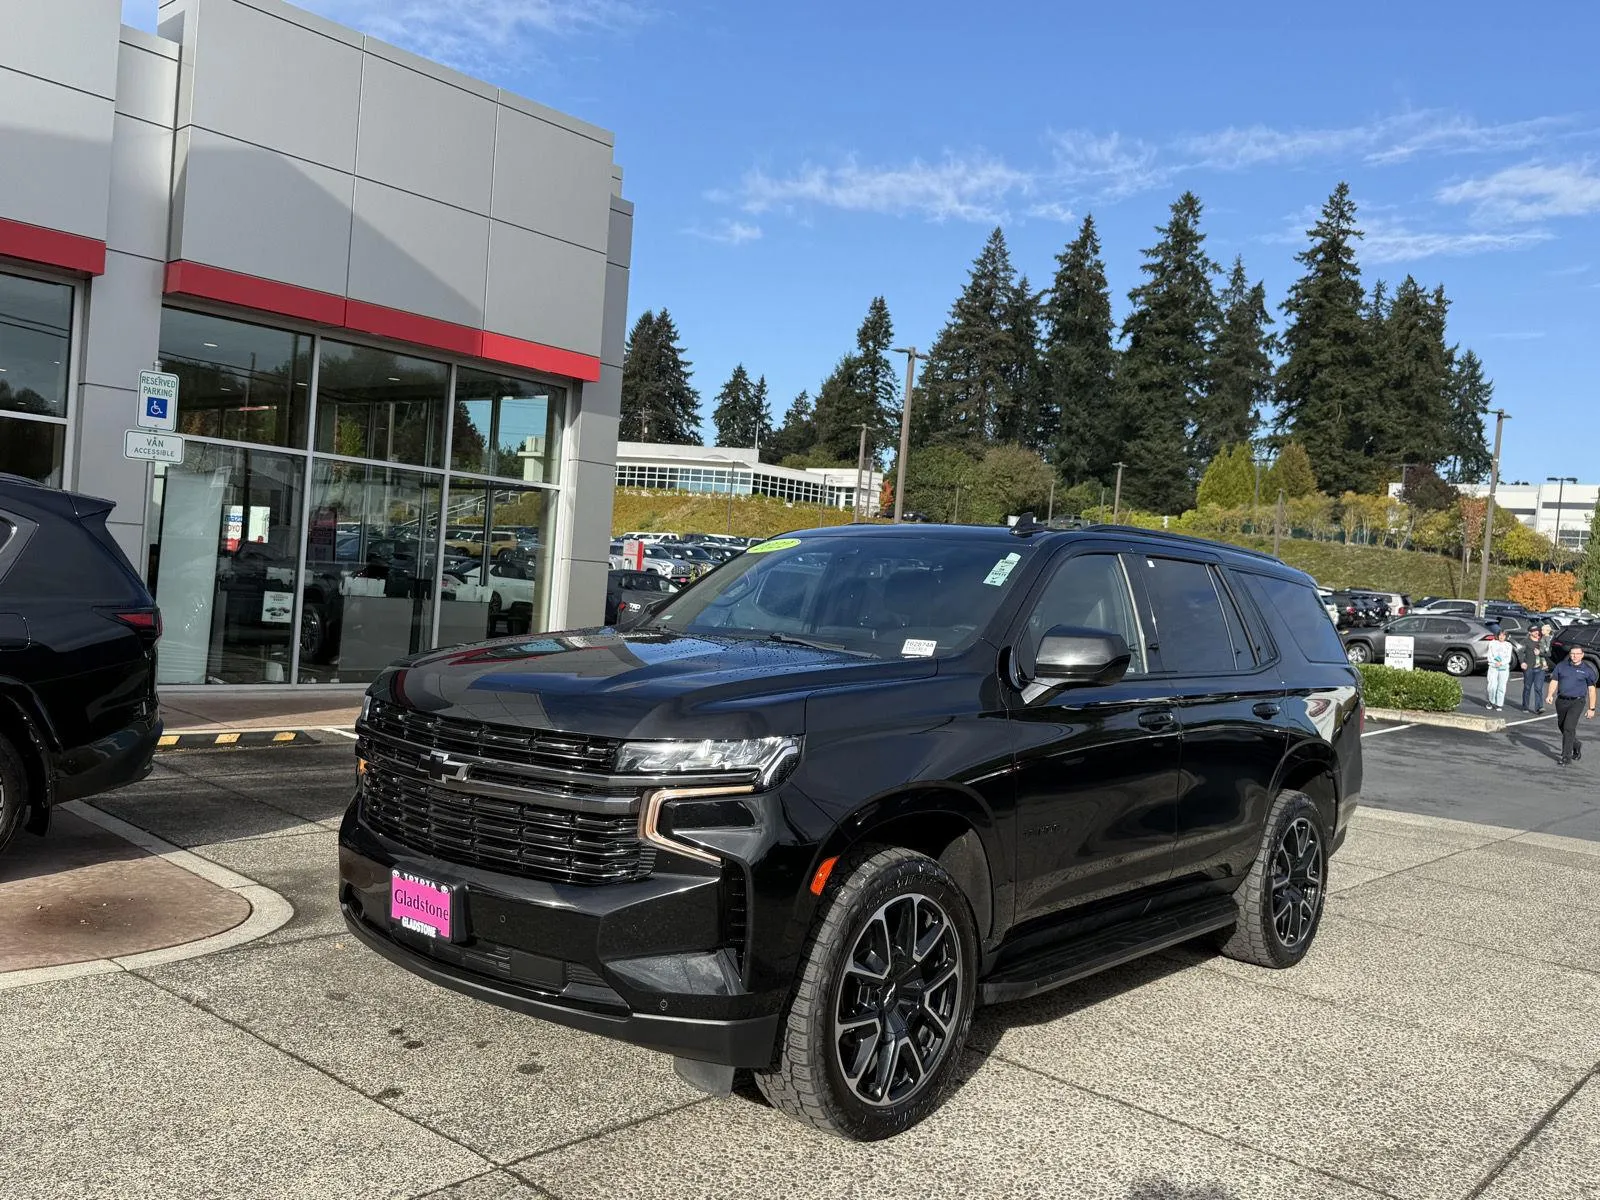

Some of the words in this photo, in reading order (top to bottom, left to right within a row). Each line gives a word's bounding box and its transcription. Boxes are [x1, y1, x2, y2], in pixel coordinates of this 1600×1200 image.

[142, 376, 175, 388] RESERVED
[143, 387, 173, 397] PARKING
[146, 438, 164, 447] VAN
[134, 447, 175, 457] ACCESSIBLE
[403, 873, 437, 889] TOYOTA
[394, 889, 448, 921] Gladstone
[401, 916, 437, 938] GLADSTONE
